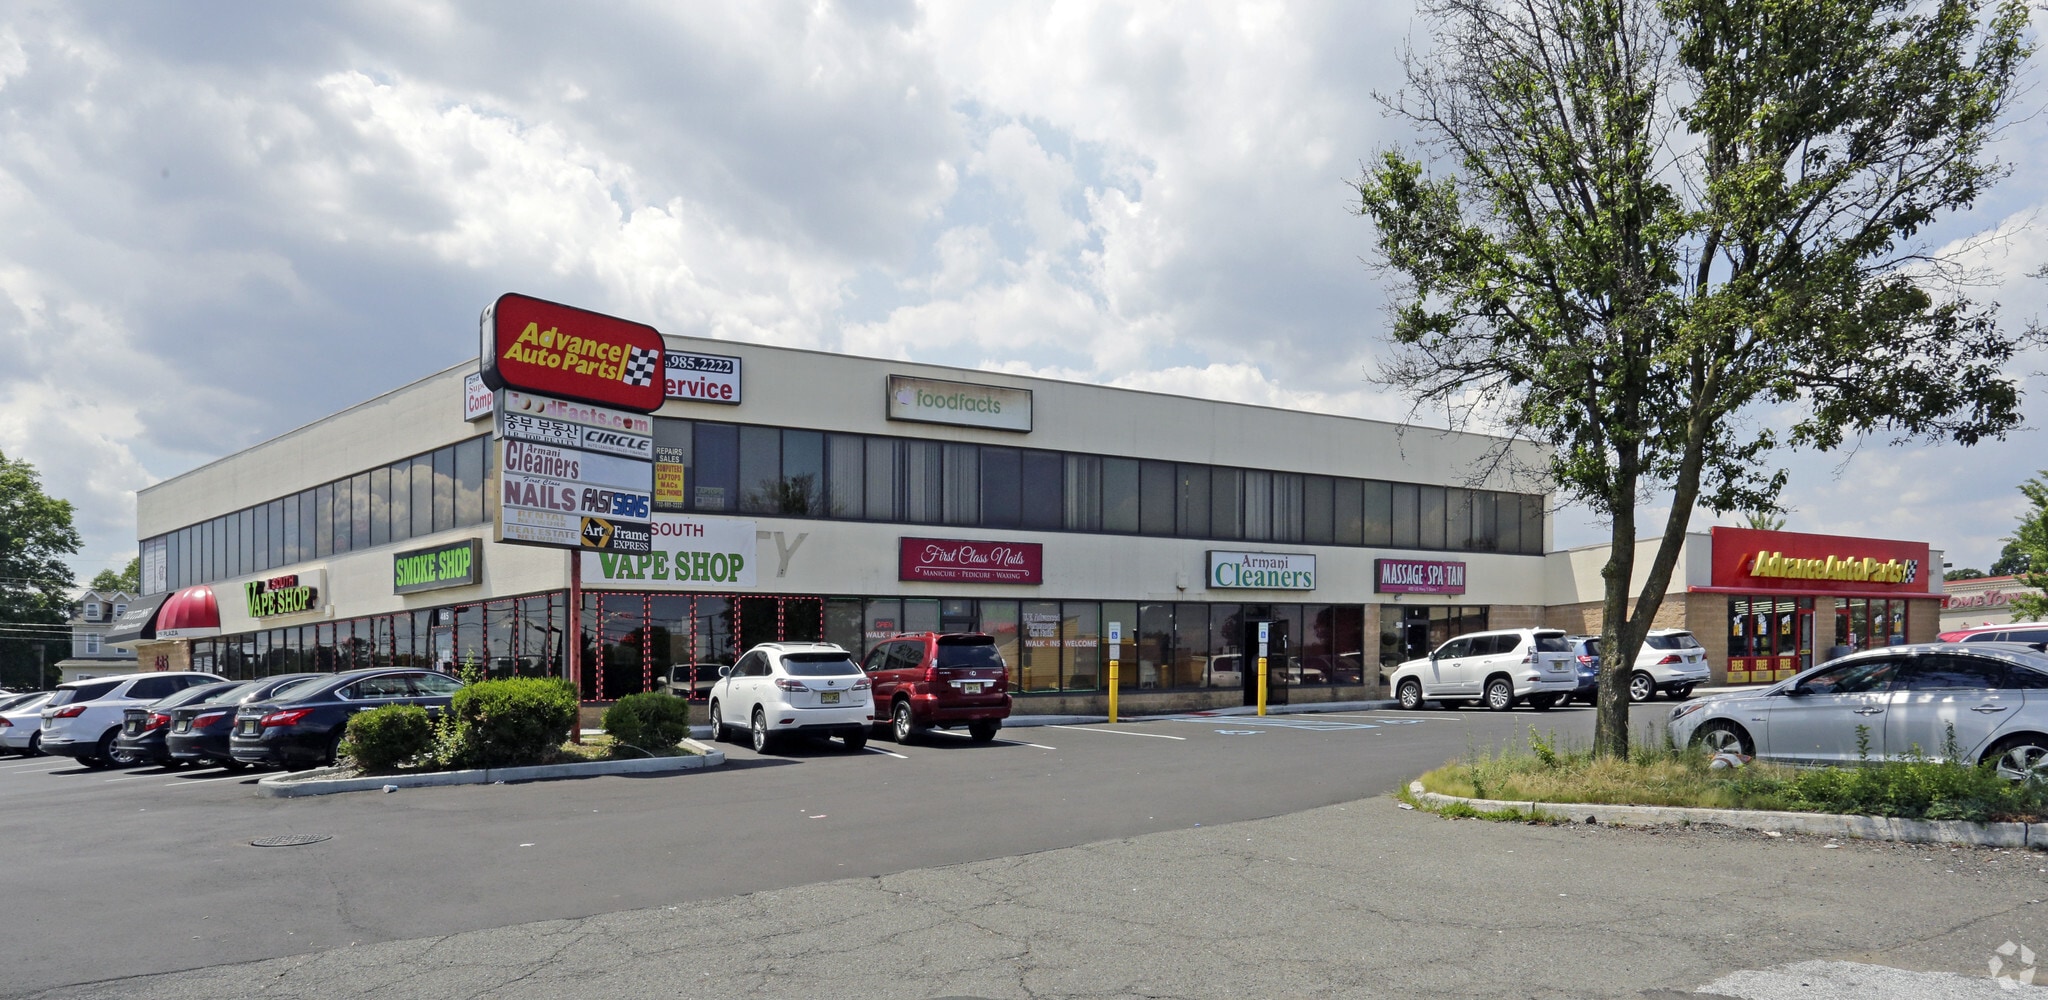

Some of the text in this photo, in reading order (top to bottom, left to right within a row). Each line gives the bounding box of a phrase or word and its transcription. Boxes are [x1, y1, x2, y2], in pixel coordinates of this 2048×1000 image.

[517, 322, 622, 362] Advance
[504, 342, 618, 380] Auto Parts
[666, 376, 733, 400] ervice
[469, 392, 492, 413] Comp
[917, 388, 1001, 414] foodfacts
[504, 414, 579, 440] 중부 부동산
[526, 444, 561, 458] Armani
[585, 431, 650, 451] CIRCLE
[505, 440, 579, 480] Cleaners
[656, 447, 683, 456] REPAIRS
[657, 473, 681, 481] LAPTOPS
[504, 480, 577, 512] NAILS
[581, 488, 649, 518] FASTSIGNS
[584, 524, 604, 537] Art
[613, 525, 649, 541] Frame
[651, 522, 704, 538] SOUTH
[613, 540, 649, 551] EXPRESS
[921, 544, 1025, 566] First Class Nails
[396, 547, 471, 587] SMOKE SHOP
[599, 550, 744, 582] VAPE SHOP
[1242, 554, 1289, 570] Armani
[271, 575, 295, 590] SOUTH
[923, 569, 956, 577] MANICURE
[962, 570, 990, 578] PEDICURE
[1215, 562, 1312, 588] Cleaners
[1382, 563, 1463, 586] MASSAGE SPA TAN
[244, 581, 311, 618] VAPE SHOP
[440, 611, 450, 621] 485
[875, 621, 894, 629] OPEN
[1064, 640, 1098, 648] WELCOME
[1731, 659, 1744, 671] FREE
[1756, 659, 1768, 670] FREE
[1780, 658, 1791, 669] FREE
